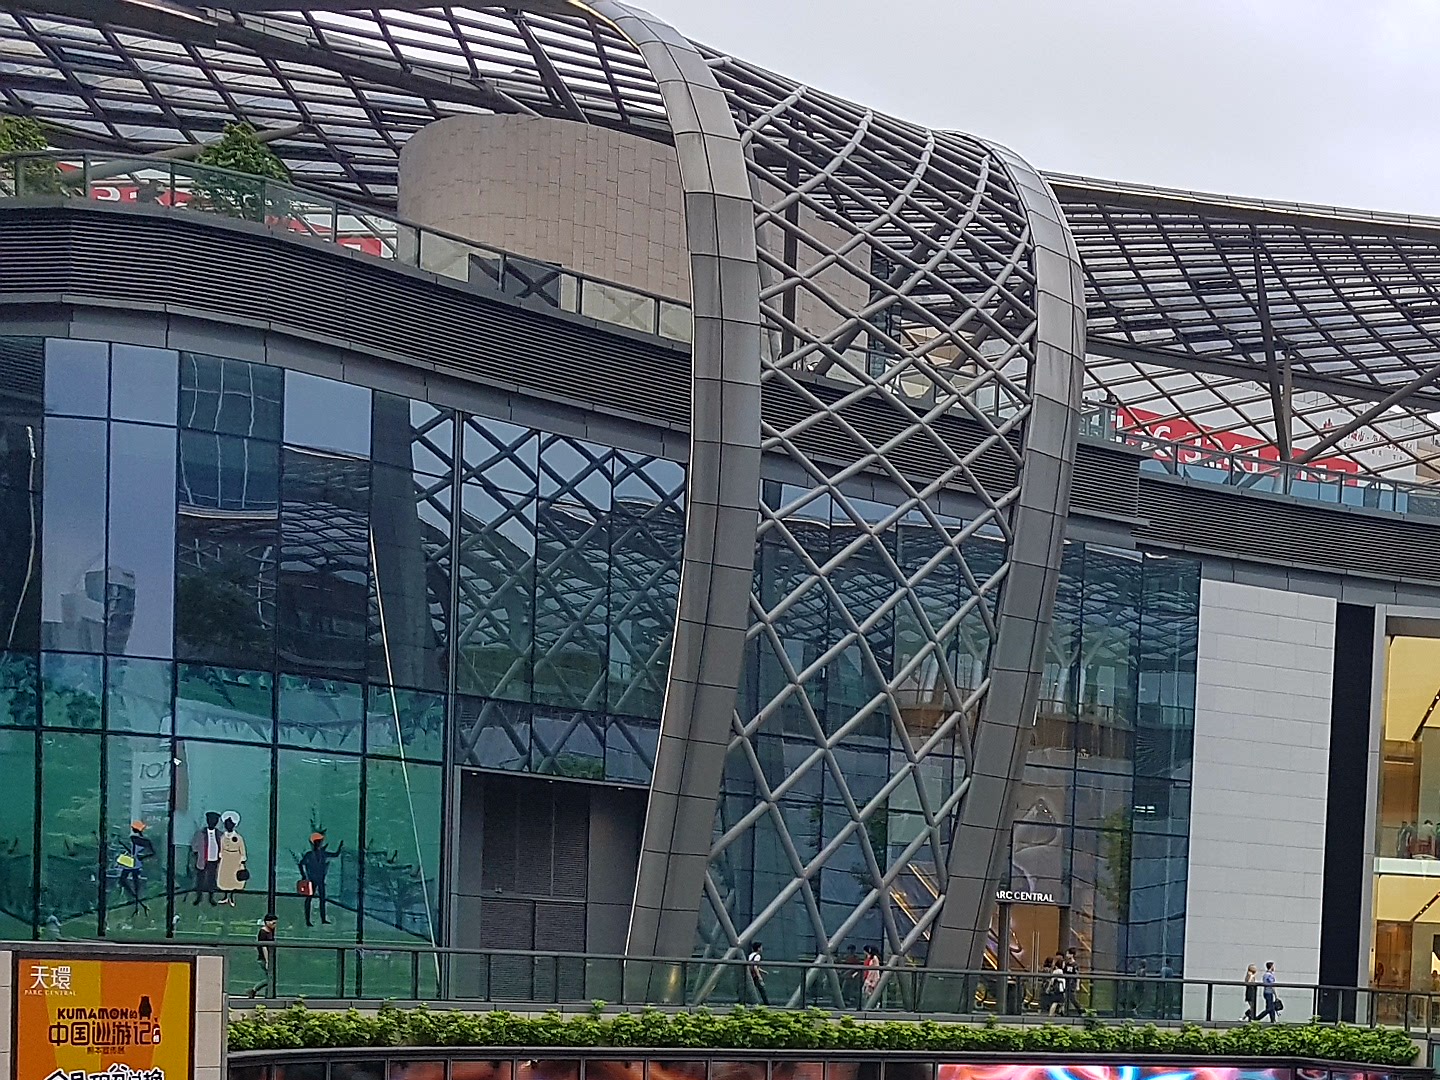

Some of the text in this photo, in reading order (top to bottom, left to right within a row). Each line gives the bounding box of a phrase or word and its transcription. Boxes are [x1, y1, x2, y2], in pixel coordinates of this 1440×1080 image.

[1014, 891, 1055, 902] CENTRAL
[30, 965, 71, 990] 天環
[49, 1021, 152, 1046] 中国巡游记
